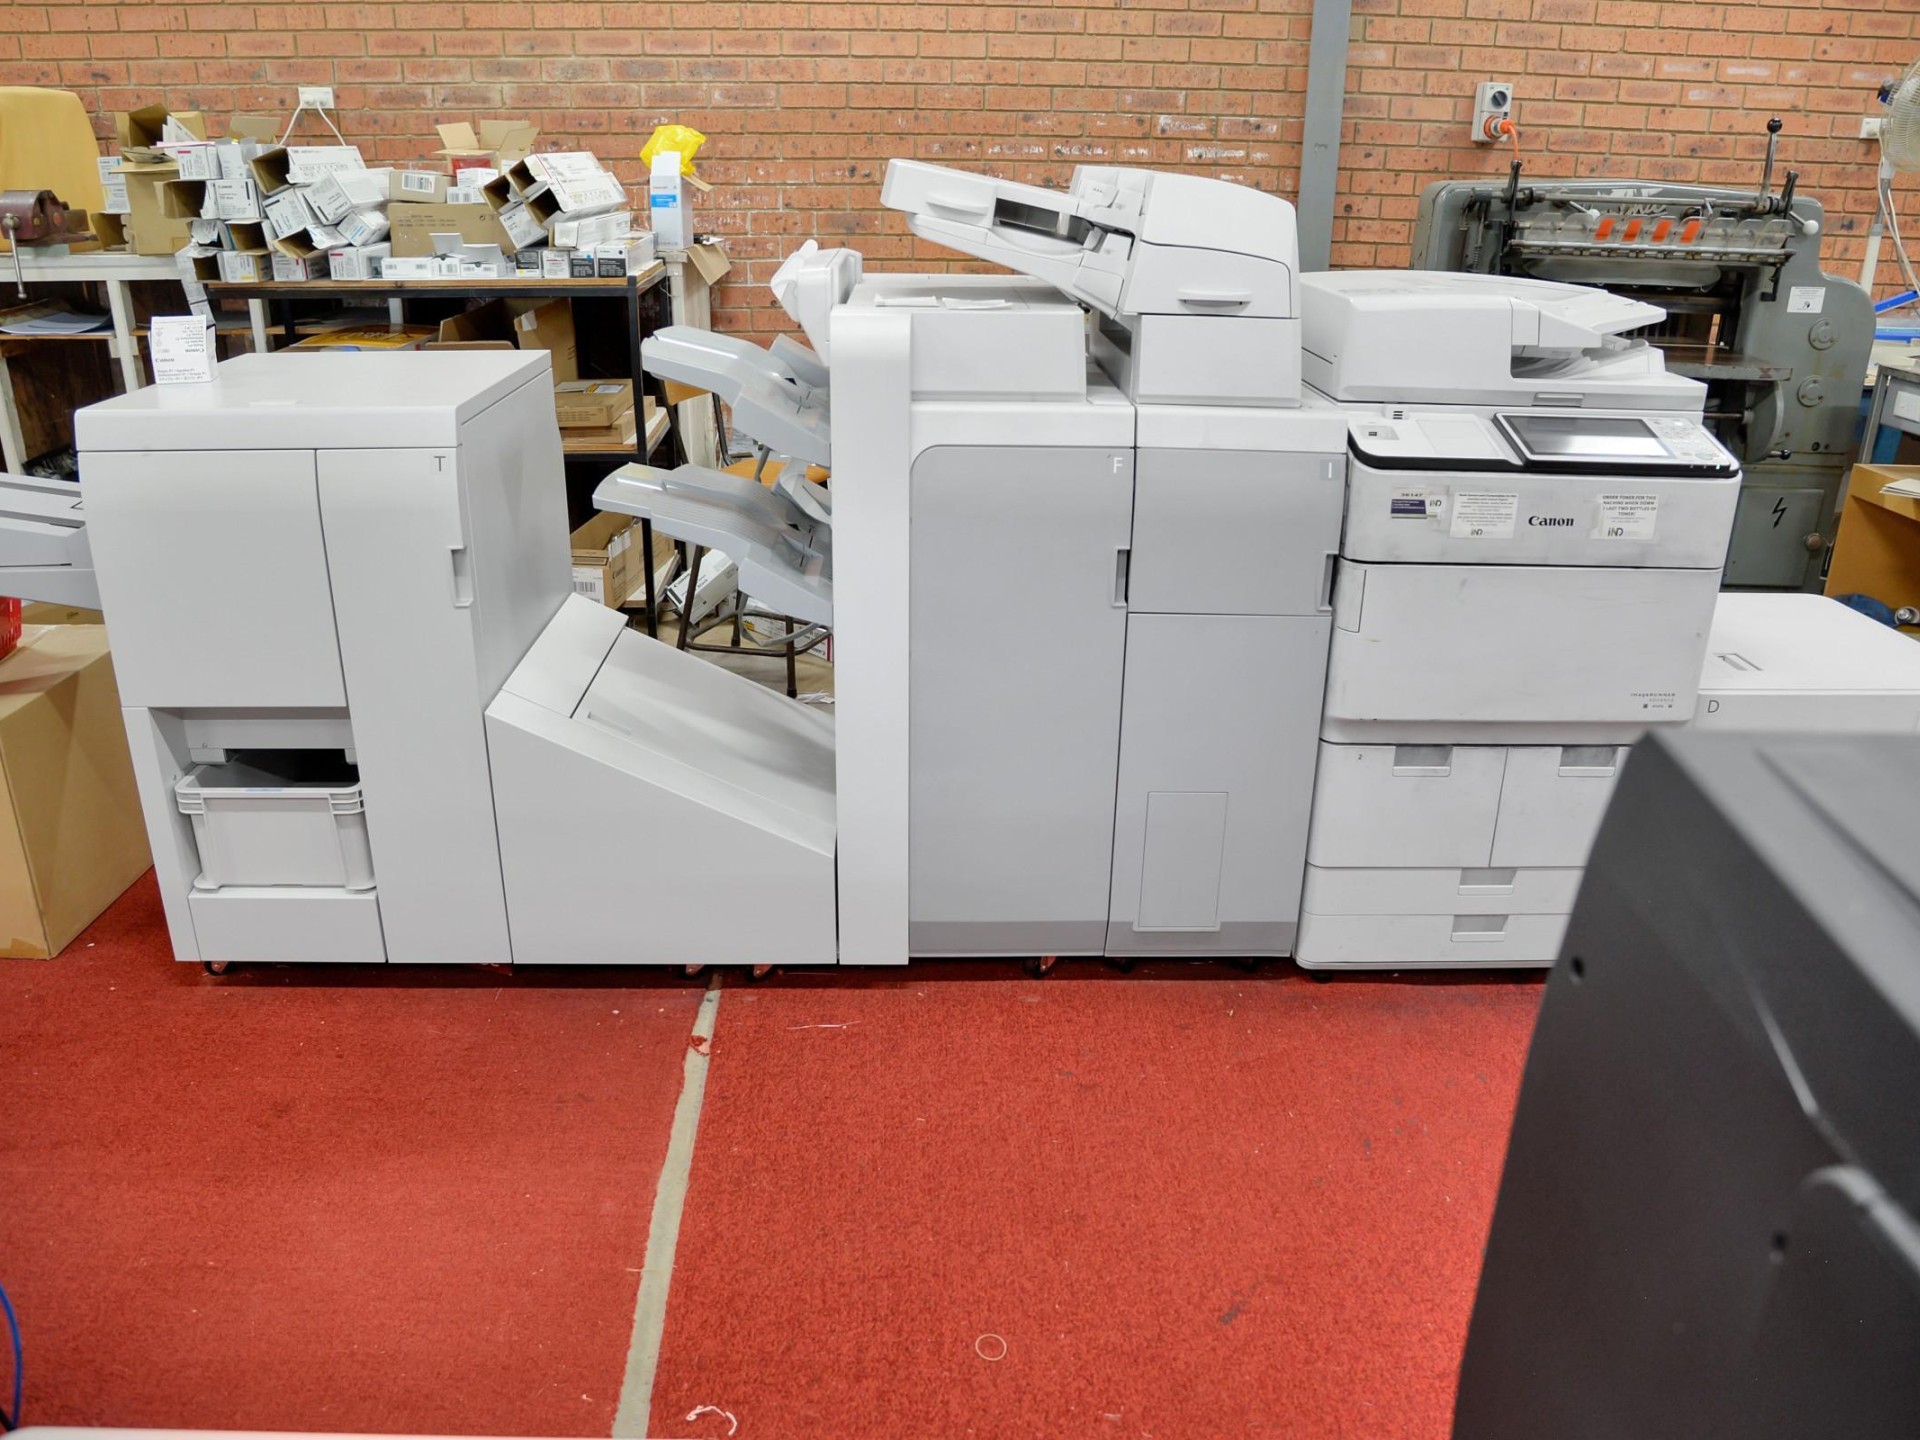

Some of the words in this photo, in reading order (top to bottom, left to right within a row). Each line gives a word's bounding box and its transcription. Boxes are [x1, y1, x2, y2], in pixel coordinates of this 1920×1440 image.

[433, 455, 447, 472] T
[1113, 457, 1123, 473] F
[1528, 515, 1574, 527] Canon
[1708, 699, 1720, 713] D
